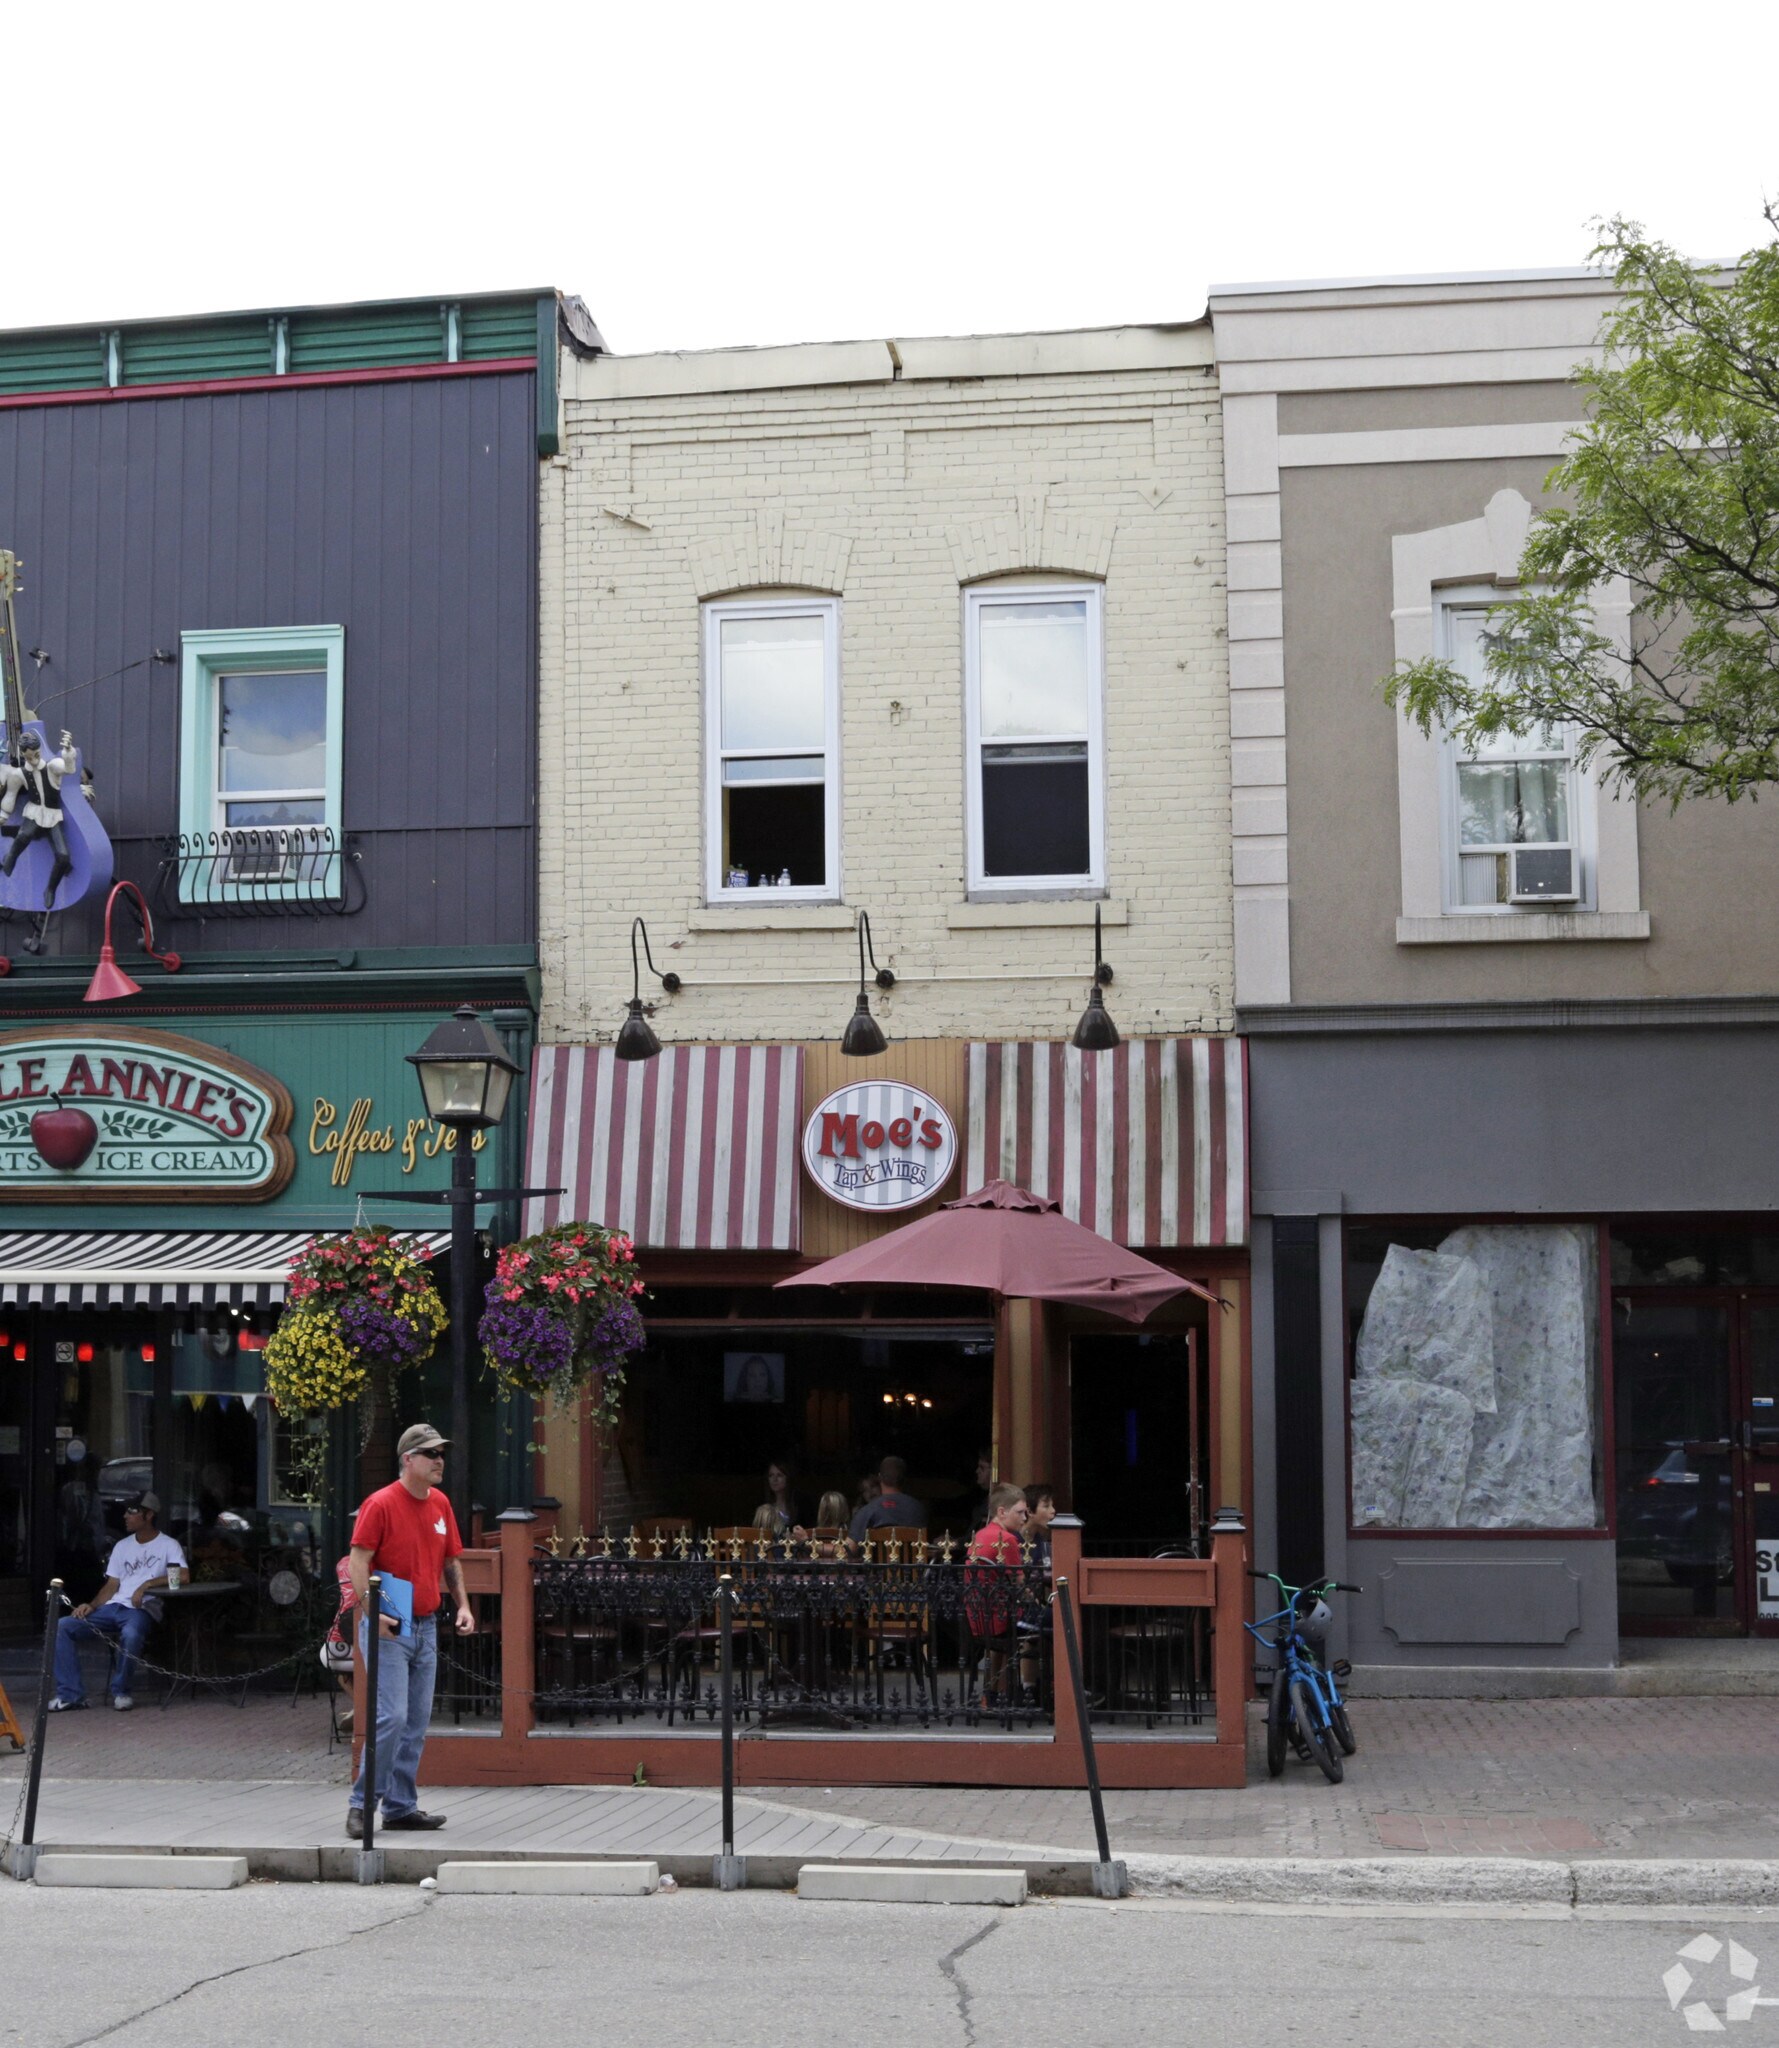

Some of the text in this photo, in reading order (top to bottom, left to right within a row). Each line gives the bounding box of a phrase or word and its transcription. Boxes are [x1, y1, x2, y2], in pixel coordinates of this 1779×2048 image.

[58, 1053, 257, 1138] ANNIE'S
[309, 1096, 488, 1187] Coffees & Tes
[817, 1106, 944, 1159] Moe's
[95, 1151, 144, 1171] ICE
[151, 1151, 257, 1171] CREAM
[834, 1157, 927, 1191] Tap & Wings
